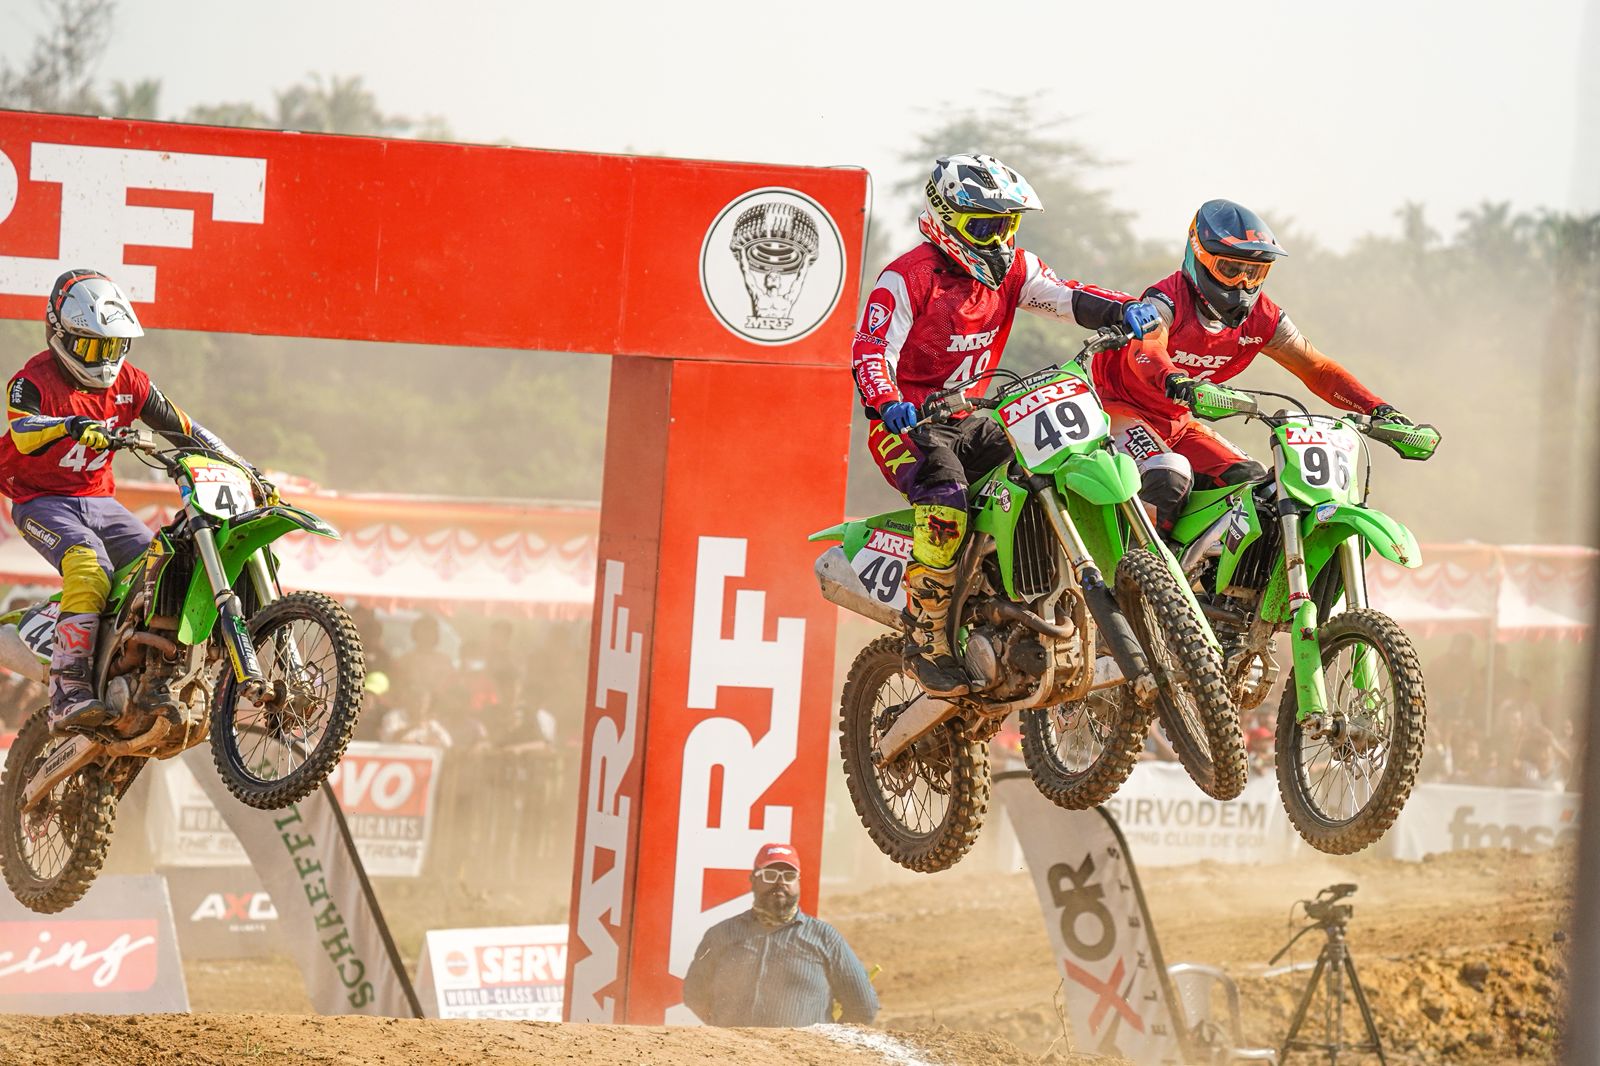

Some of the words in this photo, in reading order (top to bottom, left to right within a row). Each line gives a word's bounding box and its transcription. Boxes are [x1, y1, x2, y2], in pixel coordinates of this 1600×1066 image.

[925, 179, 955, 222] 100%
[0, 142, 268, 303] F
[47, 298, 65, 339] 00%
[745, 316, 794, 330] MRF
[855, 331, 890, 348] SPORTS
[946, 325, 1000, 352] MRF
[1170, 349, 1233, 369] MRF
[1003, 377, 1084, 426] MRF
[1034, 401, 1090, 452] 49
[1303, 447, 1350, 491] 96
[869, 531, 914, 556] MRF
[858, 556, 903, 603] 49
[334, 760, 416, 811] VO
[1106, 798, 1267, 829] SIRVODEM
[272, 797, 376, 1010] SCHAEFFL
